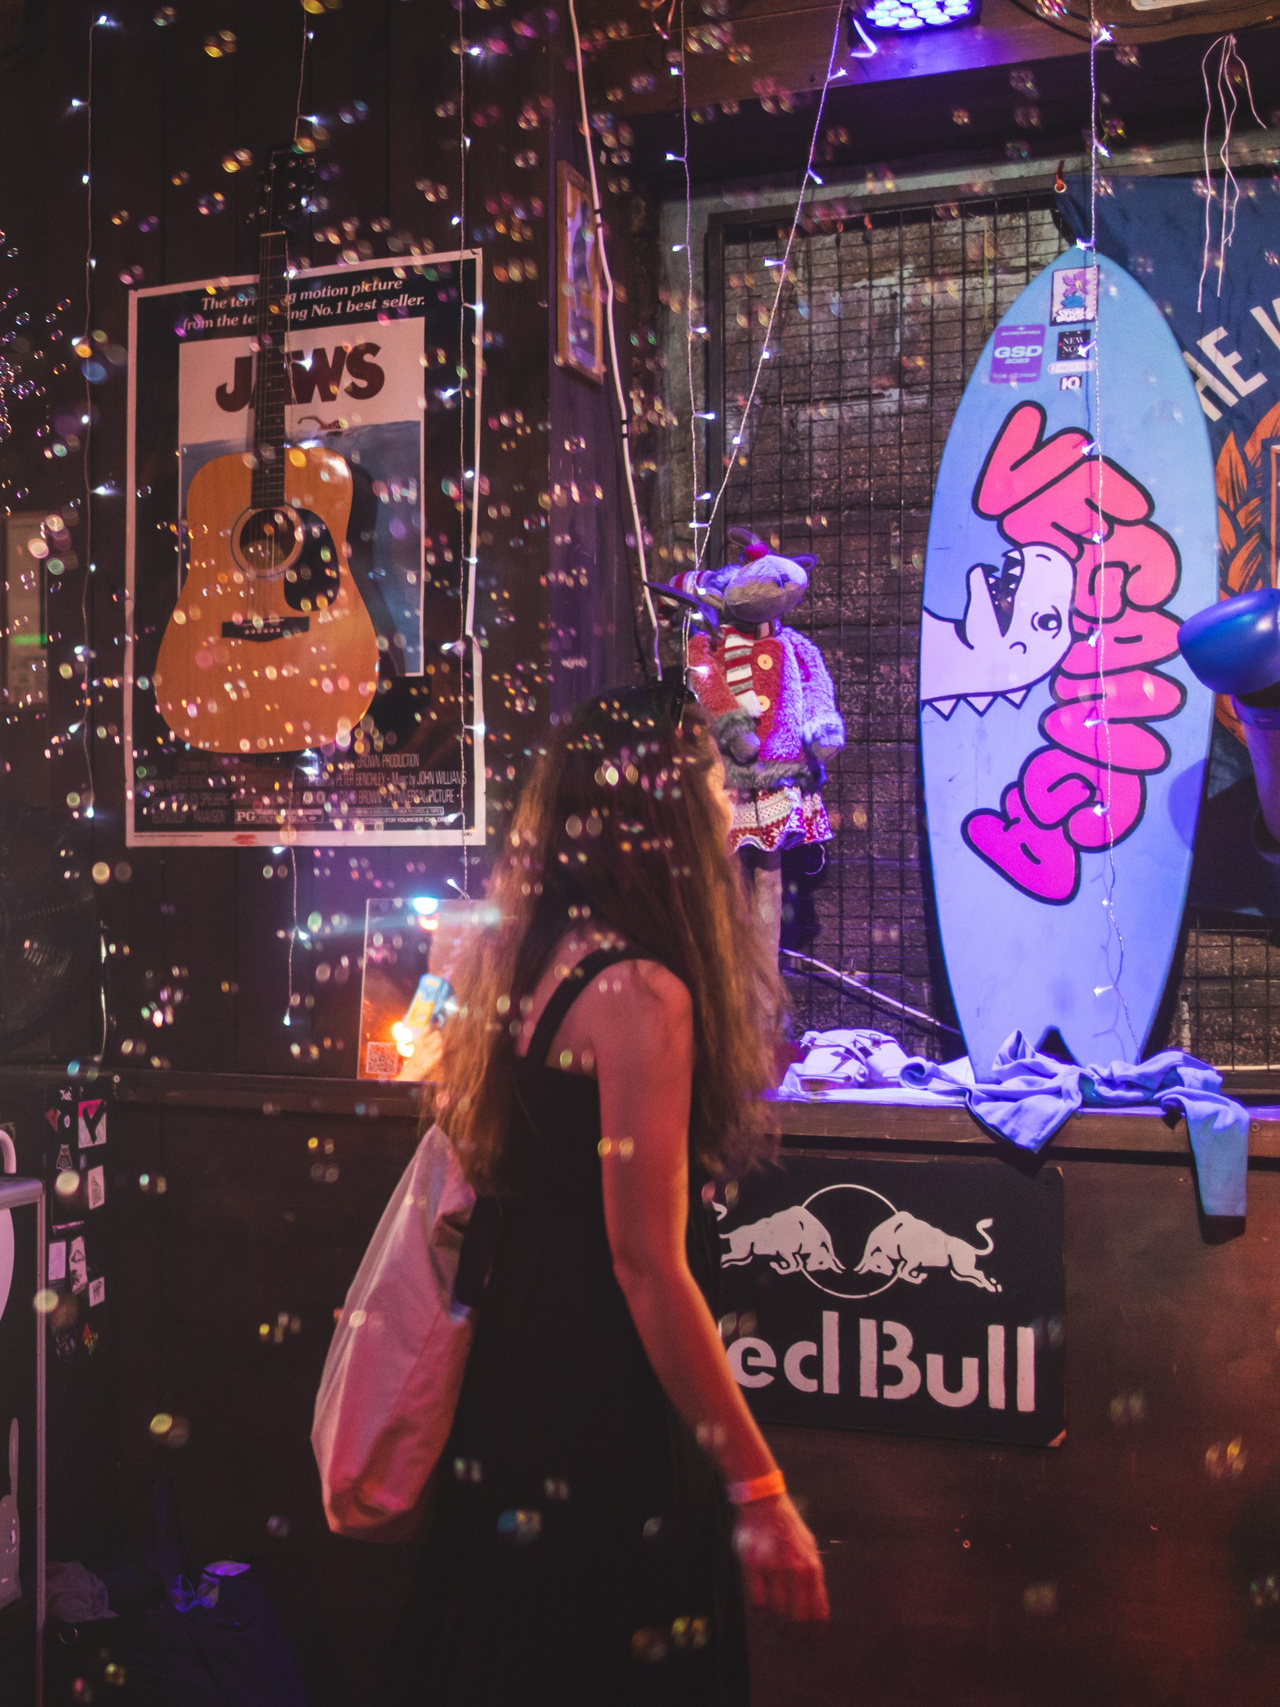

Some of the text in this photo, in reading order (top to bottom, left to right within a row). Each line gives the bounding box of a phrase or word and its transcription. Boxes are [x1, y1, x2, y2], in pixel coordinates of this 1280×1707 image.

[201, 297, 229, 311] The
[300, 285, 353, 301] motion
[355, 279, 403, 297] picture
[183, 317, 215, 332] from
[217, 314, 241, 328] the
[346, 297, 377, 314] best
[381, 295, 426, 310] seller.
[1063, 336, 1083, 344] NEW
[994, 345, 1043, 359] GSD
[215, 342, 385, 412] JWS
[381, 752, 420, 768] PRODUCTION
[417, 770, 435, 786] JOHN
[435, 770, 467, 786] WILLIAMS
[429, 788, 455, 804] PICTURE
[236, 811, 256, 822] PG
[723, 1310, 1035, 1412] ed Bull
